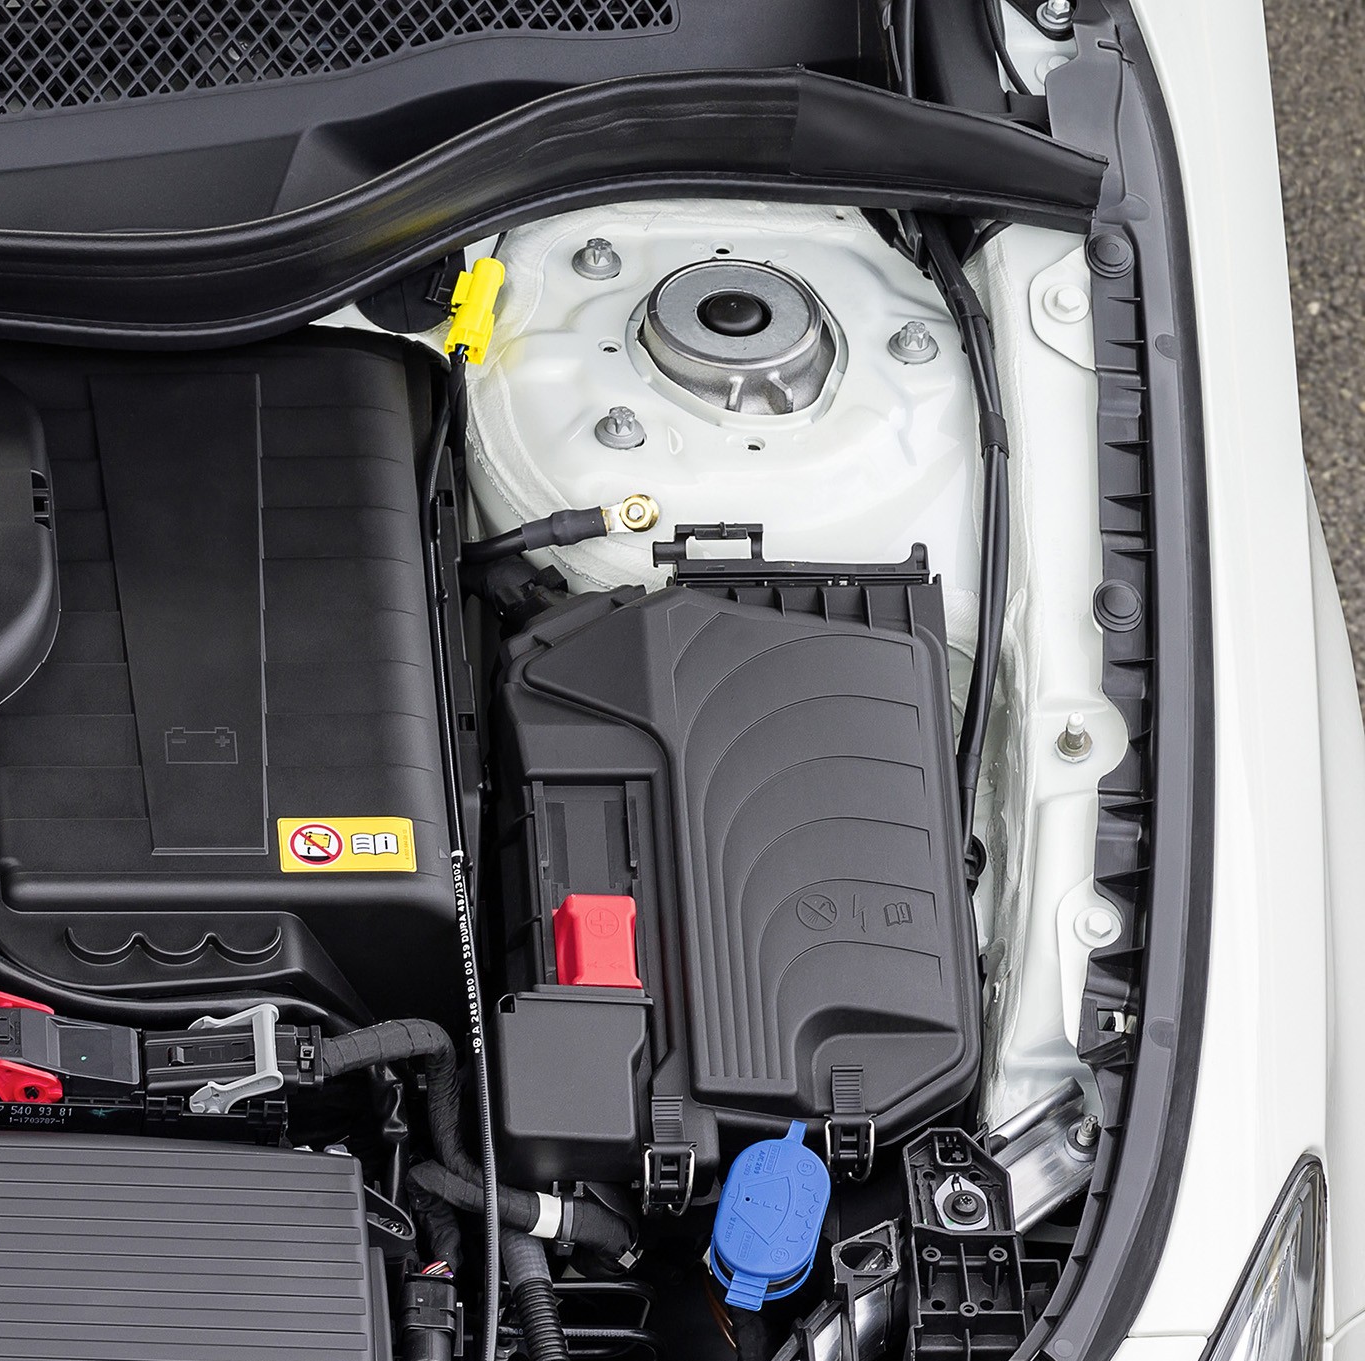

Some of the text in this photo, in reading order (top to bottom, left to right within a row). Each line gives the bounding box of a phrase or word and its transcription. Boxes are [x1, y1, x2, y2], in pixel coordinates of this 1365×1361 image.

[459, 913, 469, 943] DURA
[462, 944, 471, 959] 59
[464, 961, 473, 976] 00
[466, 978, 476, 1001] 880
[469, 1001, 479, 1024] 246
[471, 1026, 481, 1034] A
[10, 1105, 32, 1115] 540
[38, 1106, 52, 1116] 93
[59, 1107, 73, 1117] 81
